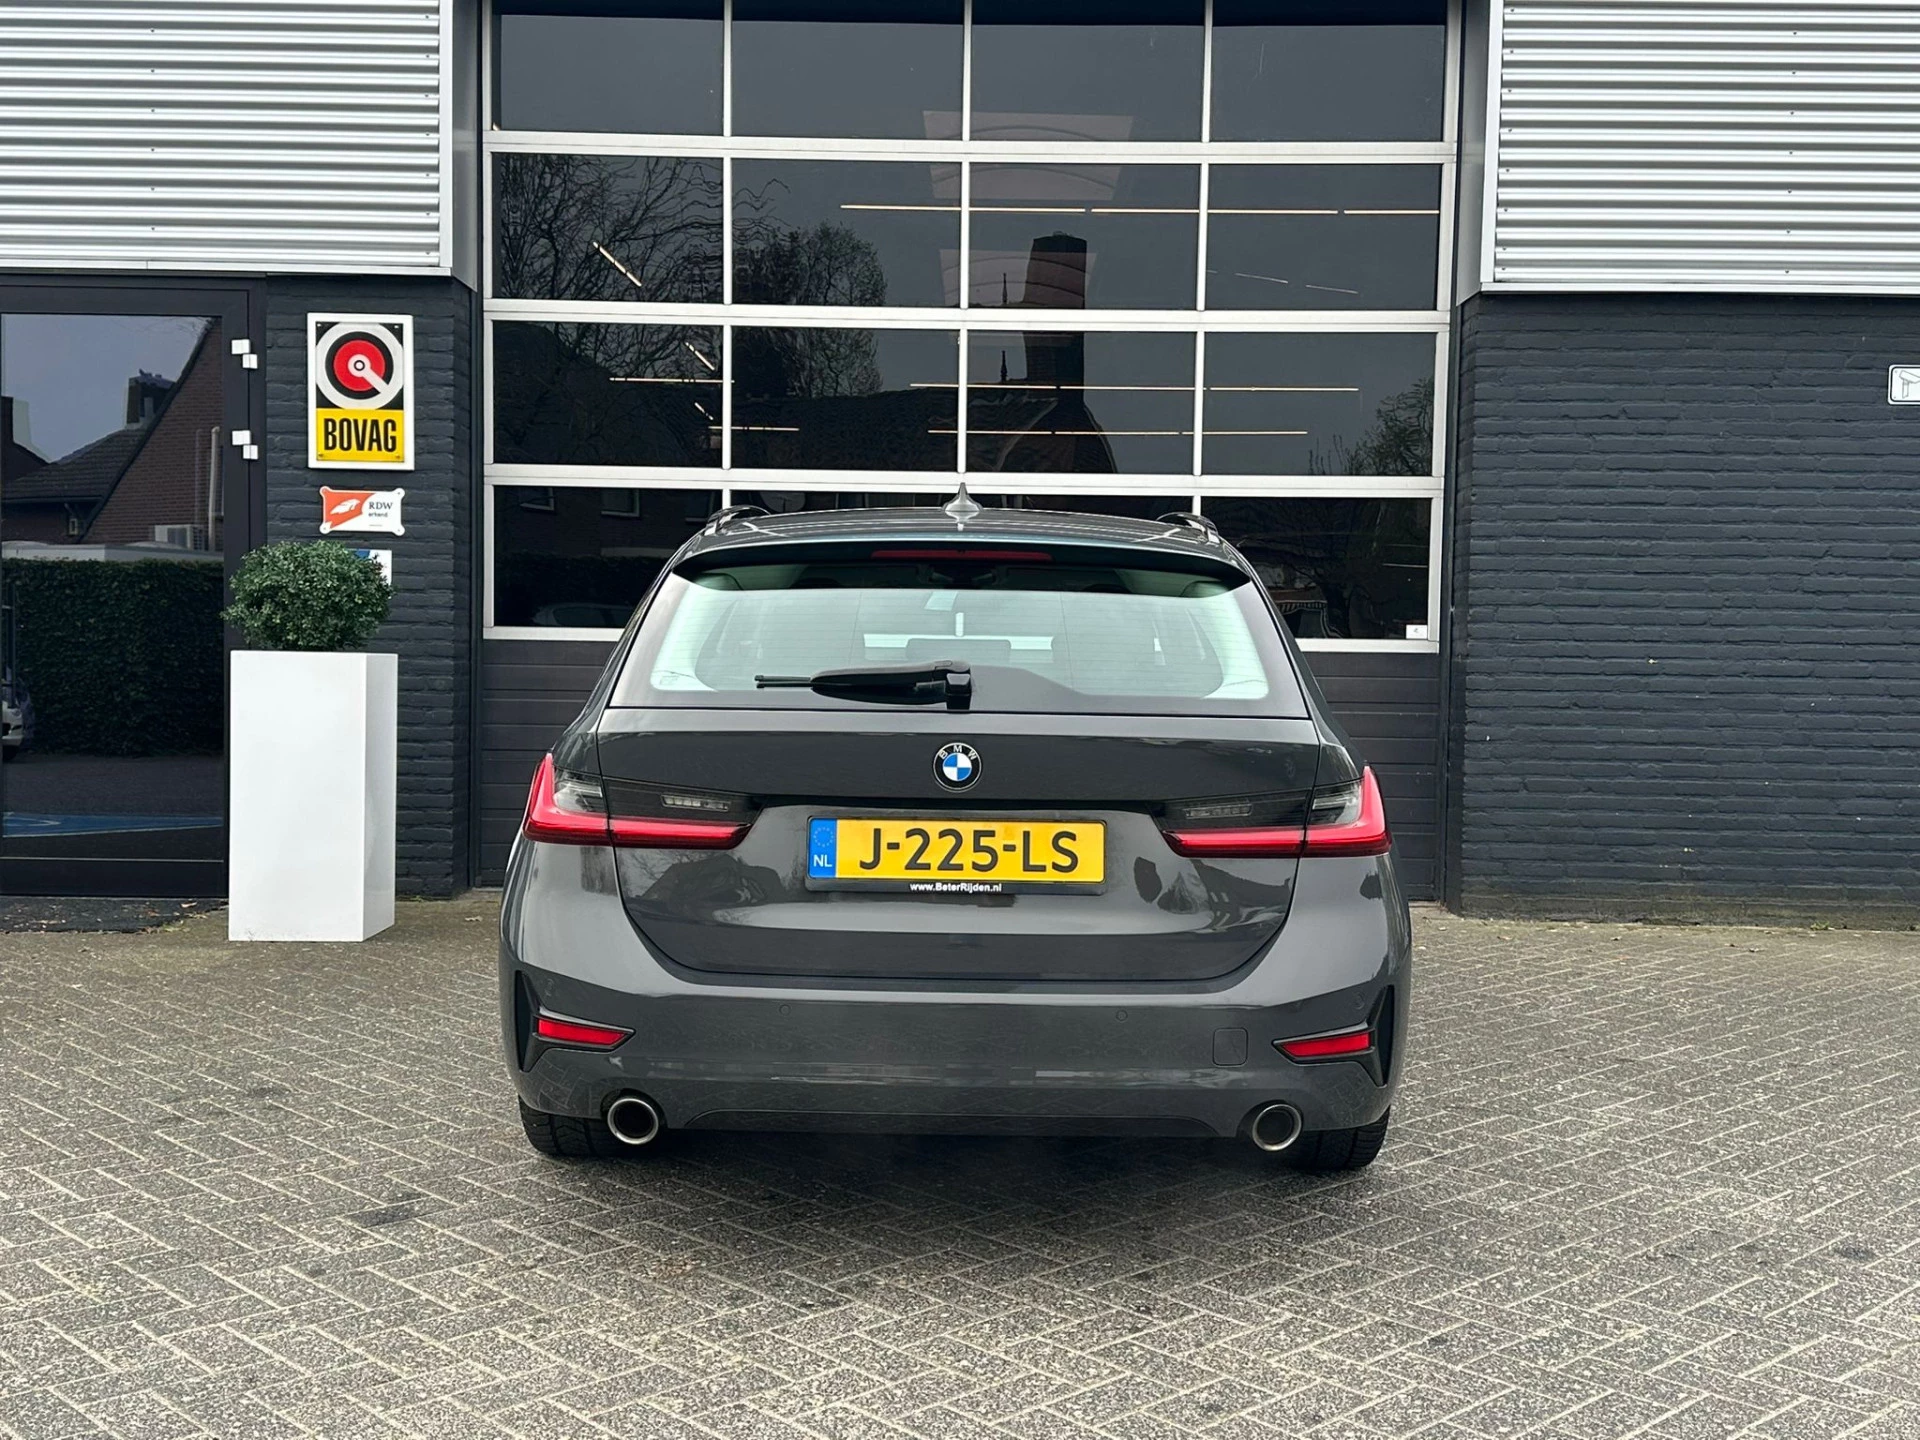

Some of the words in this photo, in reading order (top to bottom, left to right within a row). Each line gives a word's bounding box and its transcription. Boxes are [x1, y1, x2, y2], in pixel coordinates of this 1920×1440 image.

[324, 417, 397, 452] BOVAG
[368, 501, 393, 510] RDW
[938, 744, 977, 761] BMW
[859, 827, 1079, 874] J-225-LS
[813, 855, 832, 868] NL
[909, 881, 1002, 894] www.BeterRijden.nl
